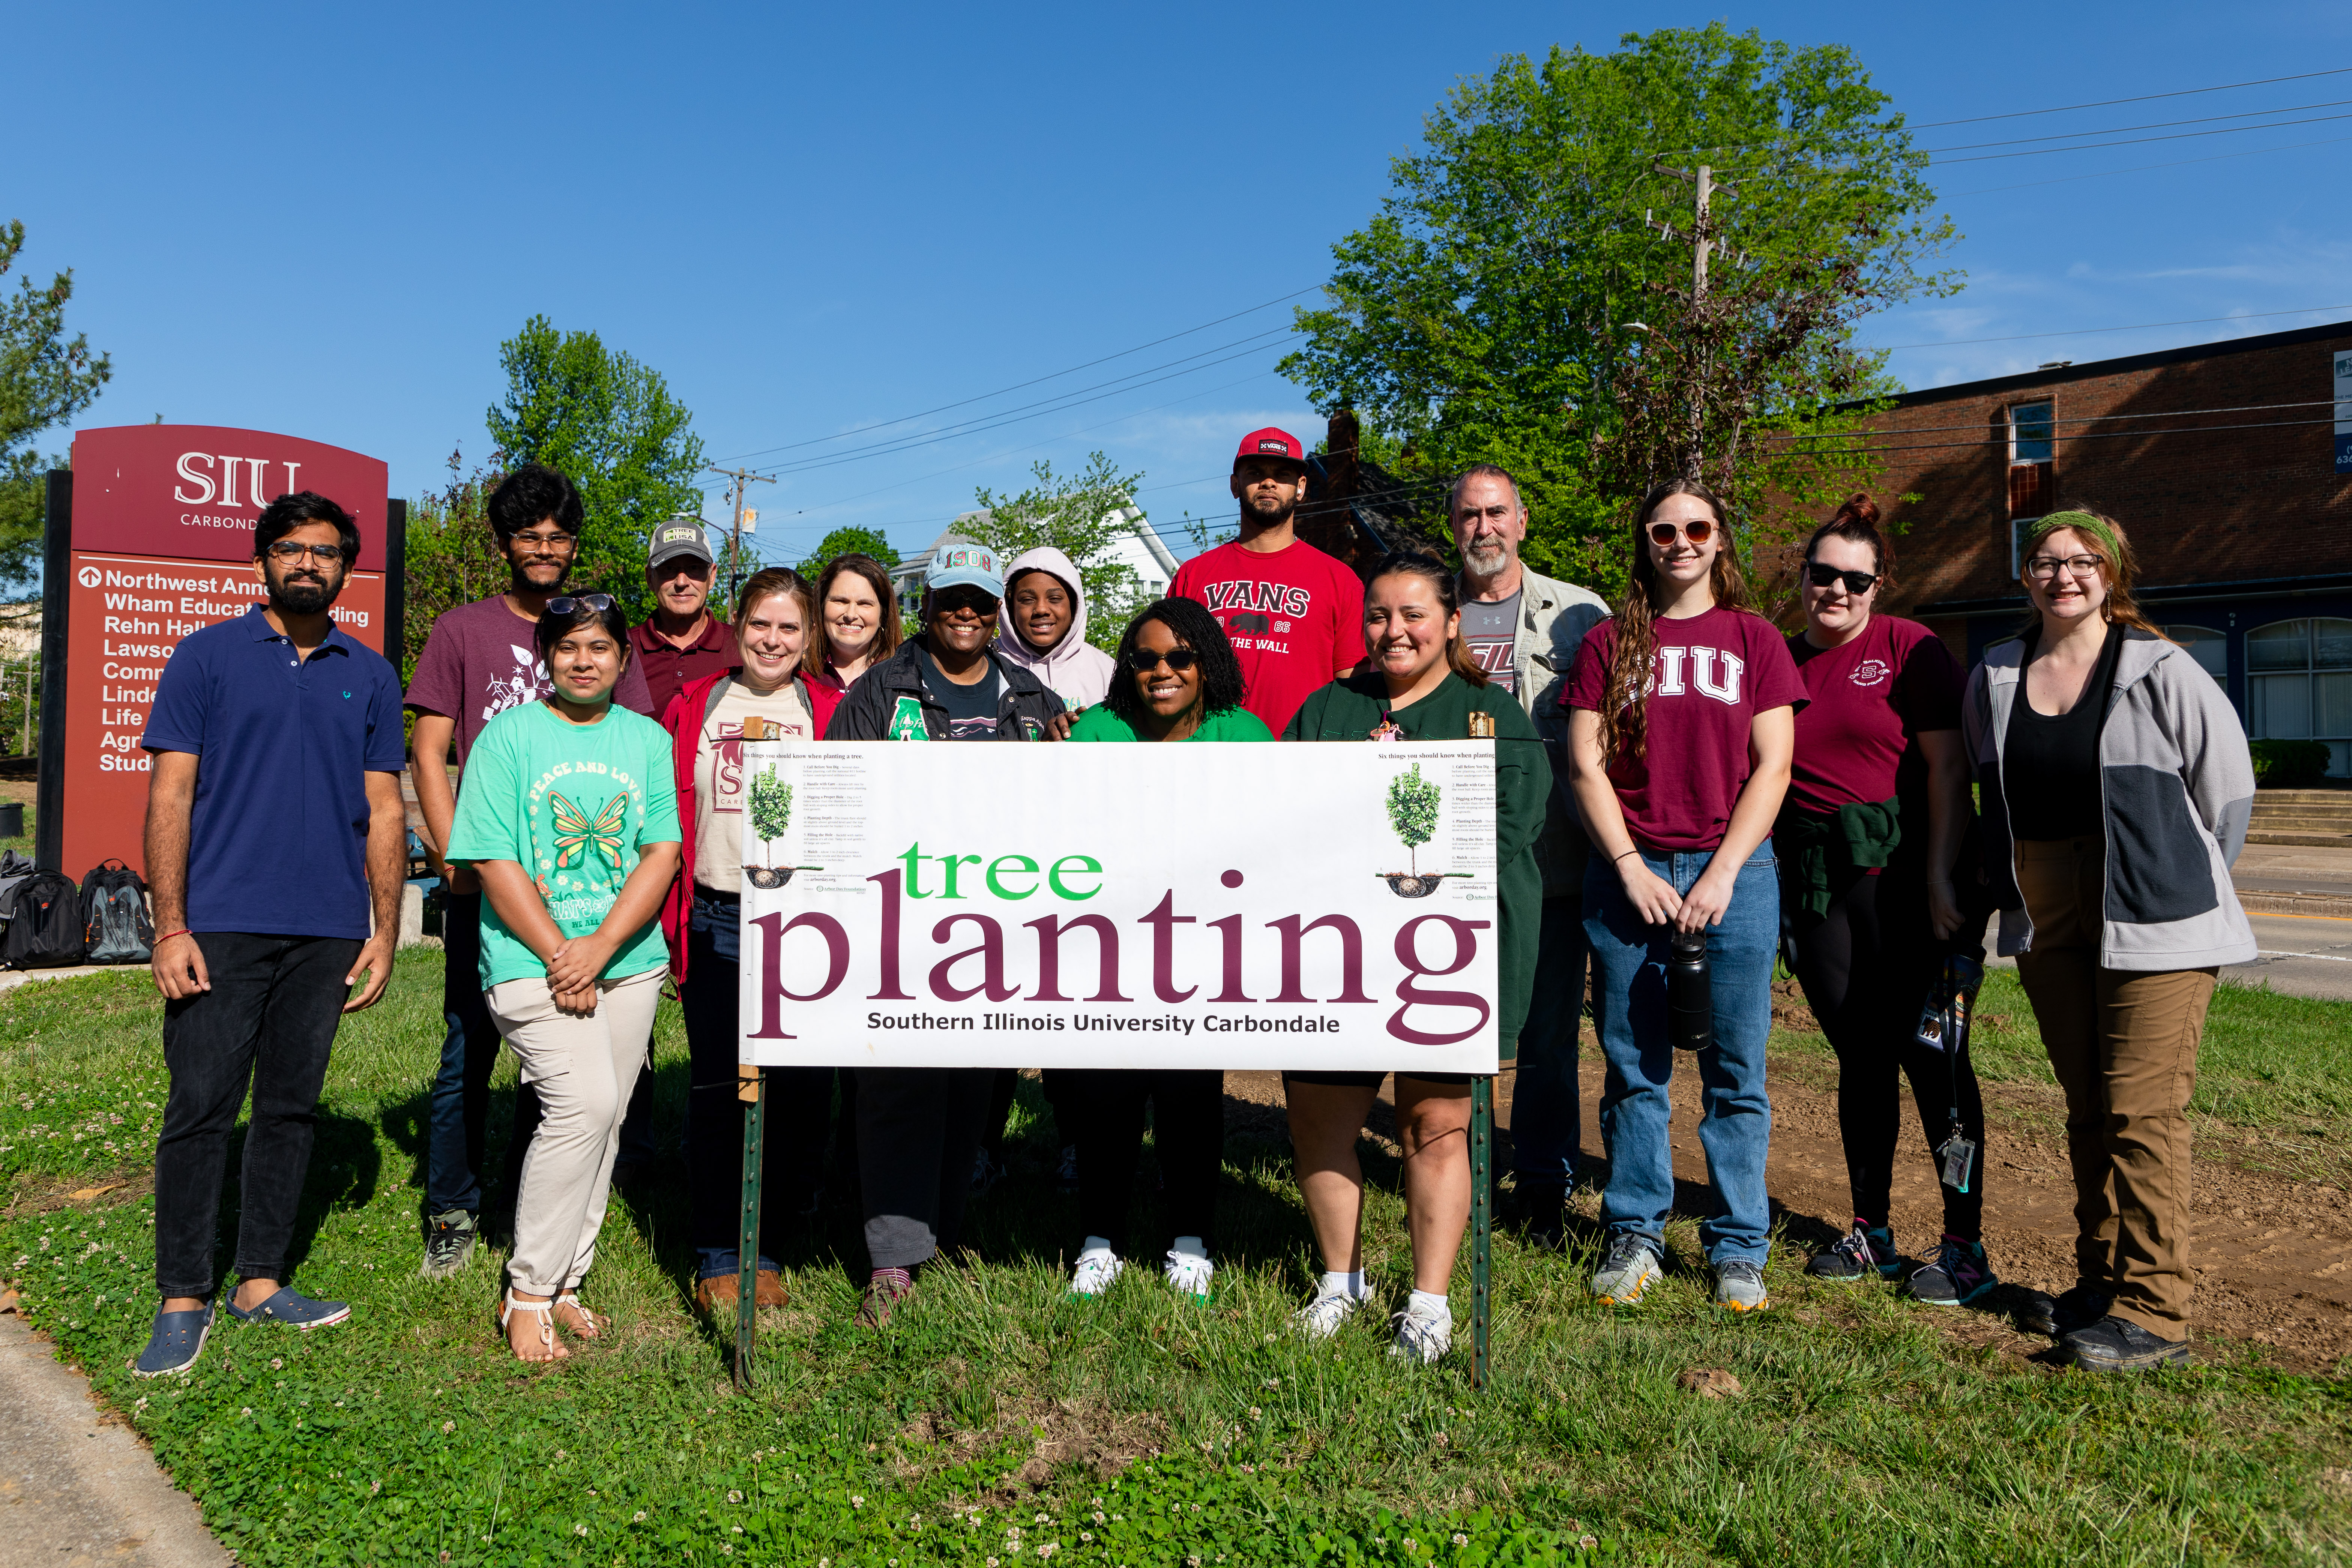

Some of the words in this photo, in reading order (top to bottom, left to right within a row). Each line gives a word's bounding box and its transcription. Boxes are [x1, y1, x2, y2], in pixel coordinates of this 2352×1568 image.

[2340, 367, 2352, 375] LEA
[2336, 456, 2352, 464] 636
[174, 452, 301, 509] SIU
[181, 514, 258, 530] CARBOND
[944, 550, 991, 572] 1908
[106, 570, 217, 593] Northwest
[1204, 580, 1310, 618] VANS
[104, 593, 173, 613] Wham
[181, 597, 252, 617] Educat
[329, 607, 369, 628] ding
[105, 616, 159, 635] Rehn
[1274, 620, 1291, 633] 66
[104, 639, 175, 658] Lawso
[1230, 637, 1253, 649] THE
[1256, 640, 1289, 654] WALL
[1862, 665, 1876, 679] S
[1867, 676, 1884, 686] POUND
[102, 708, 143, 725] Life
[1035, 719, 1045, 732] Alph
[100, 754, 154, 771] Stud
[529, 762, 572, 802] PEACE
[575, 761, 607, 774] AND
[611, 767, 641, 801] LOVE
[720, 765, 743, 795] S
[897, 841, 1103, 901] tree
[548, 898, 592, 920] HAT'S
[746, 868, 1491, 1046] planting
[868, 1012, 973, 1029] Southern
[984, 1014, 1065, 1030] Illinois
[1074, 1014, 1195, 1035] University
[1204, 1015, 1339, 1032] Carbondale
[1691, 1031, 1710, 1039] CIVAGO
